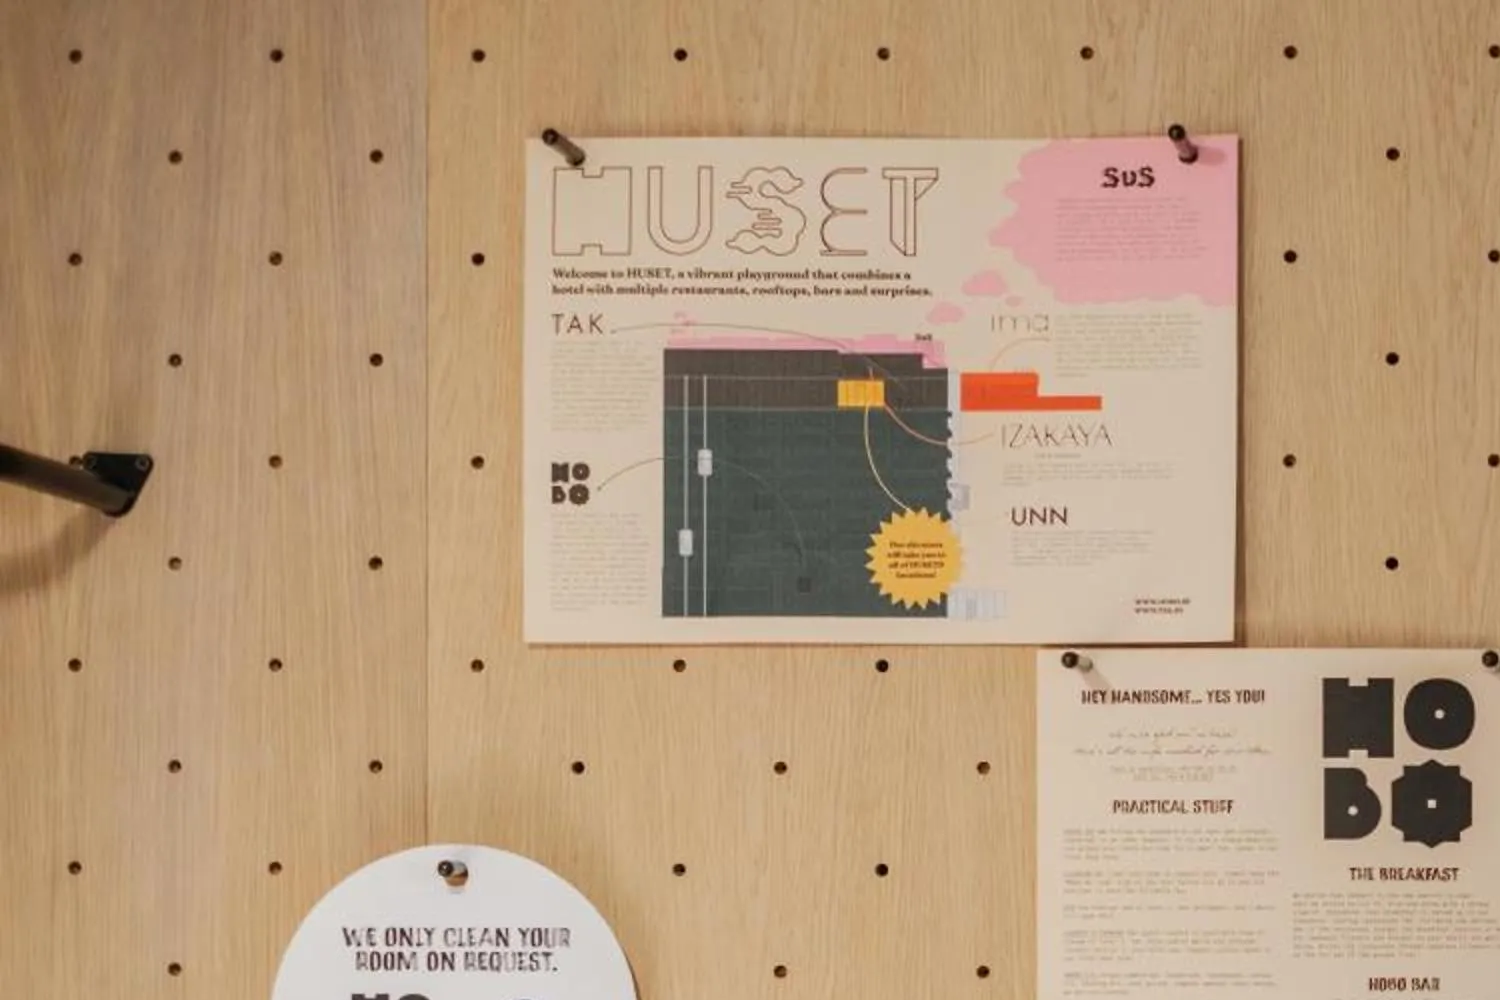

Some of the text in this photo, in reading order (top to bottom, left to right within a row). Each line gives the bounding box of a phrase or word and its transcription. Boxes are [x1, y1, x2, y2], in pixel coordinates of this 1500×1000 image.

[552, 267, 608, 280] Welcome
[611, 269, 625, 280] to
[626, 267, 675, 280] HUSET,
[687, 267, 734, 280] vibrant
[736, 267, 809, 282] playground
[812, 268, 839, 281] that
[841, 268, 901, 281] combines
[551, 283, 932, 299] hotel with multiple restaurants, rooftops, bars and surprises.
[551, 313, 604, 335] TAK
[1001, 423, 1112, 449] IZAKAYA
[1011, 506, 1068, 526] UNN
[1081, 689, 1108, 705] HEY
[1206, 689, 1231, 705] YES
[1112, 799, 1234, 815] PRACTICAL STUFF
[1348, 867, 1460, 882] THE BREAKFAST
[342, 927, 571, 949] WE ONLY CLEAN YOUR
[355, 951, 558, 973] ROOM ON REQUEST.
[1368, 977, 1440, 992] HOBO BAR
